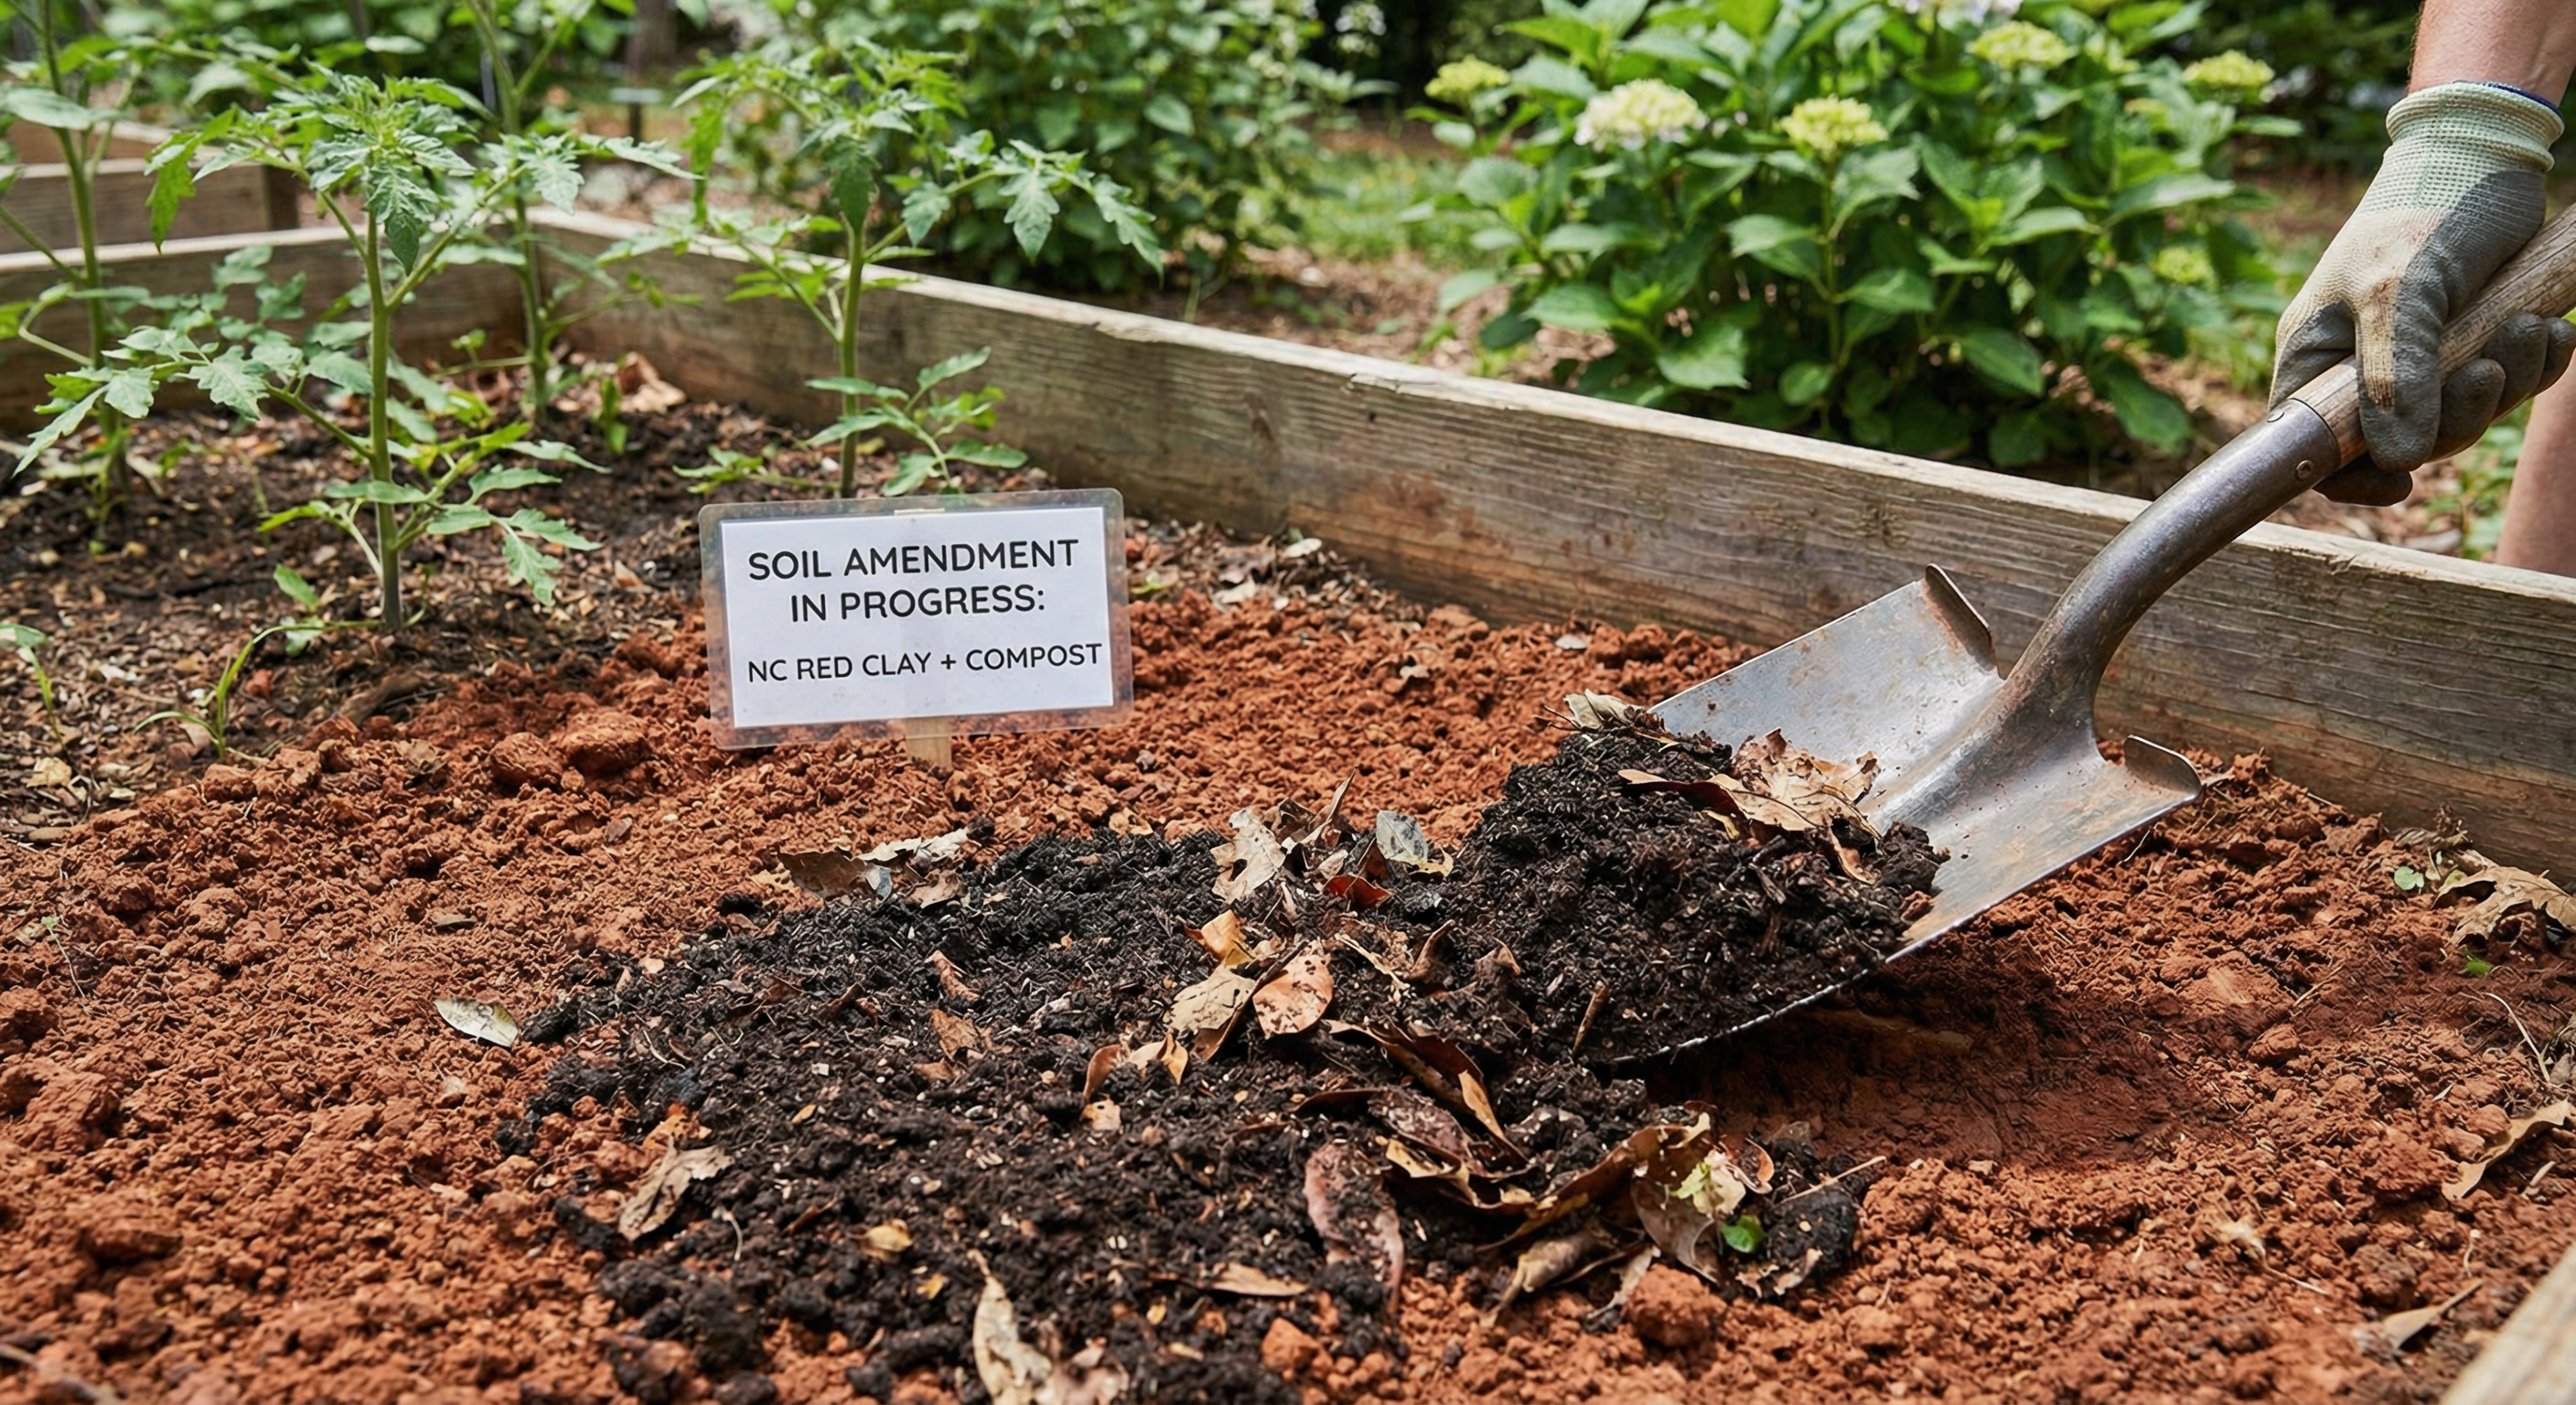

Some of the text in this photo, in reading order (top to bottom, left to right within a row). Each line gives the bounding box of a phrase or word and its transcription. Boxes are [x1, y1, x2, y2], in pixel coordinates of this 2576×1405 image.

[748, 539, 1079, 581] SOIL AMENDMENT
[791, 584, 1046, 623] IN PROGRESS:
[748, 643, 1102, 683] NC RED CLAY + COMPOST
